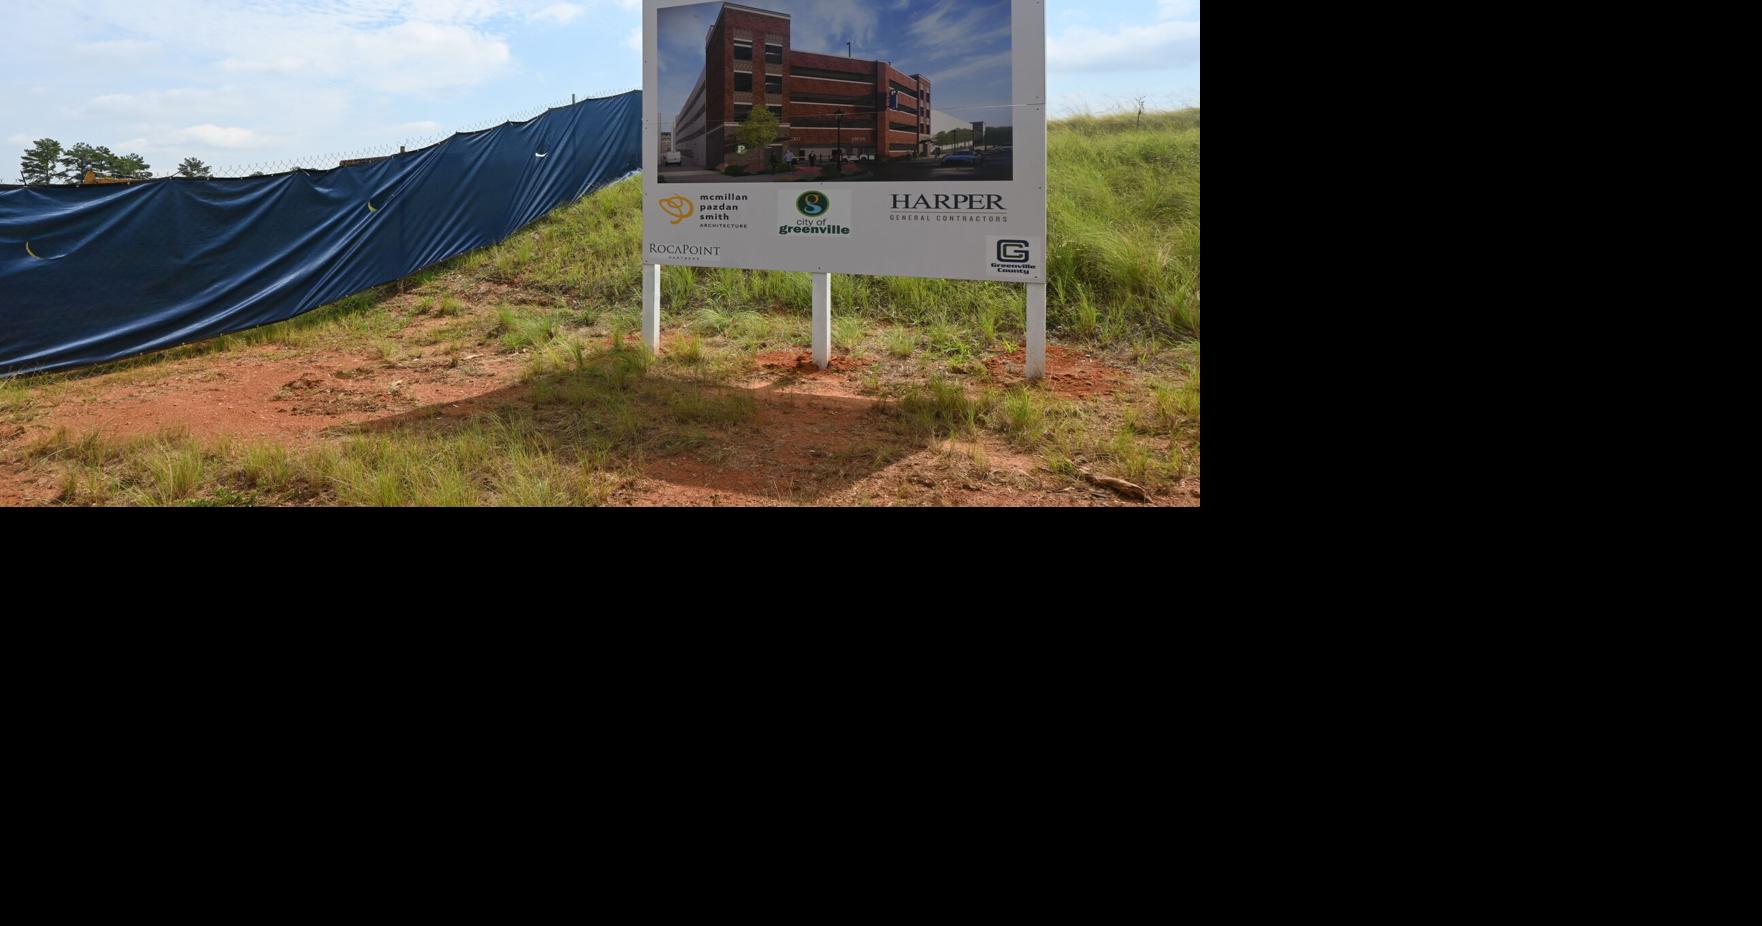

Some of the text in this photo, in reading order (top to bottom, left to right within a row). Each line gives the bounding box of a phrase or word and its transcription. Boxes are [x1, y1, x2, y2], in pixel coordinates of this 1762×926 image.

[700, 193, 748, 201] mcmillan
[889, 193, 1006, 210] HARPER
[700, 203, 738, 211] pazdan
[700, 213, 729, 221] smith
[889, 214, 1008, 223] GENERAL CONTRACTORS
[796, 218, 827, 227] city of
[779, 224, 850, 235] greenville
[990, 262, 1036, 270] Greenville
